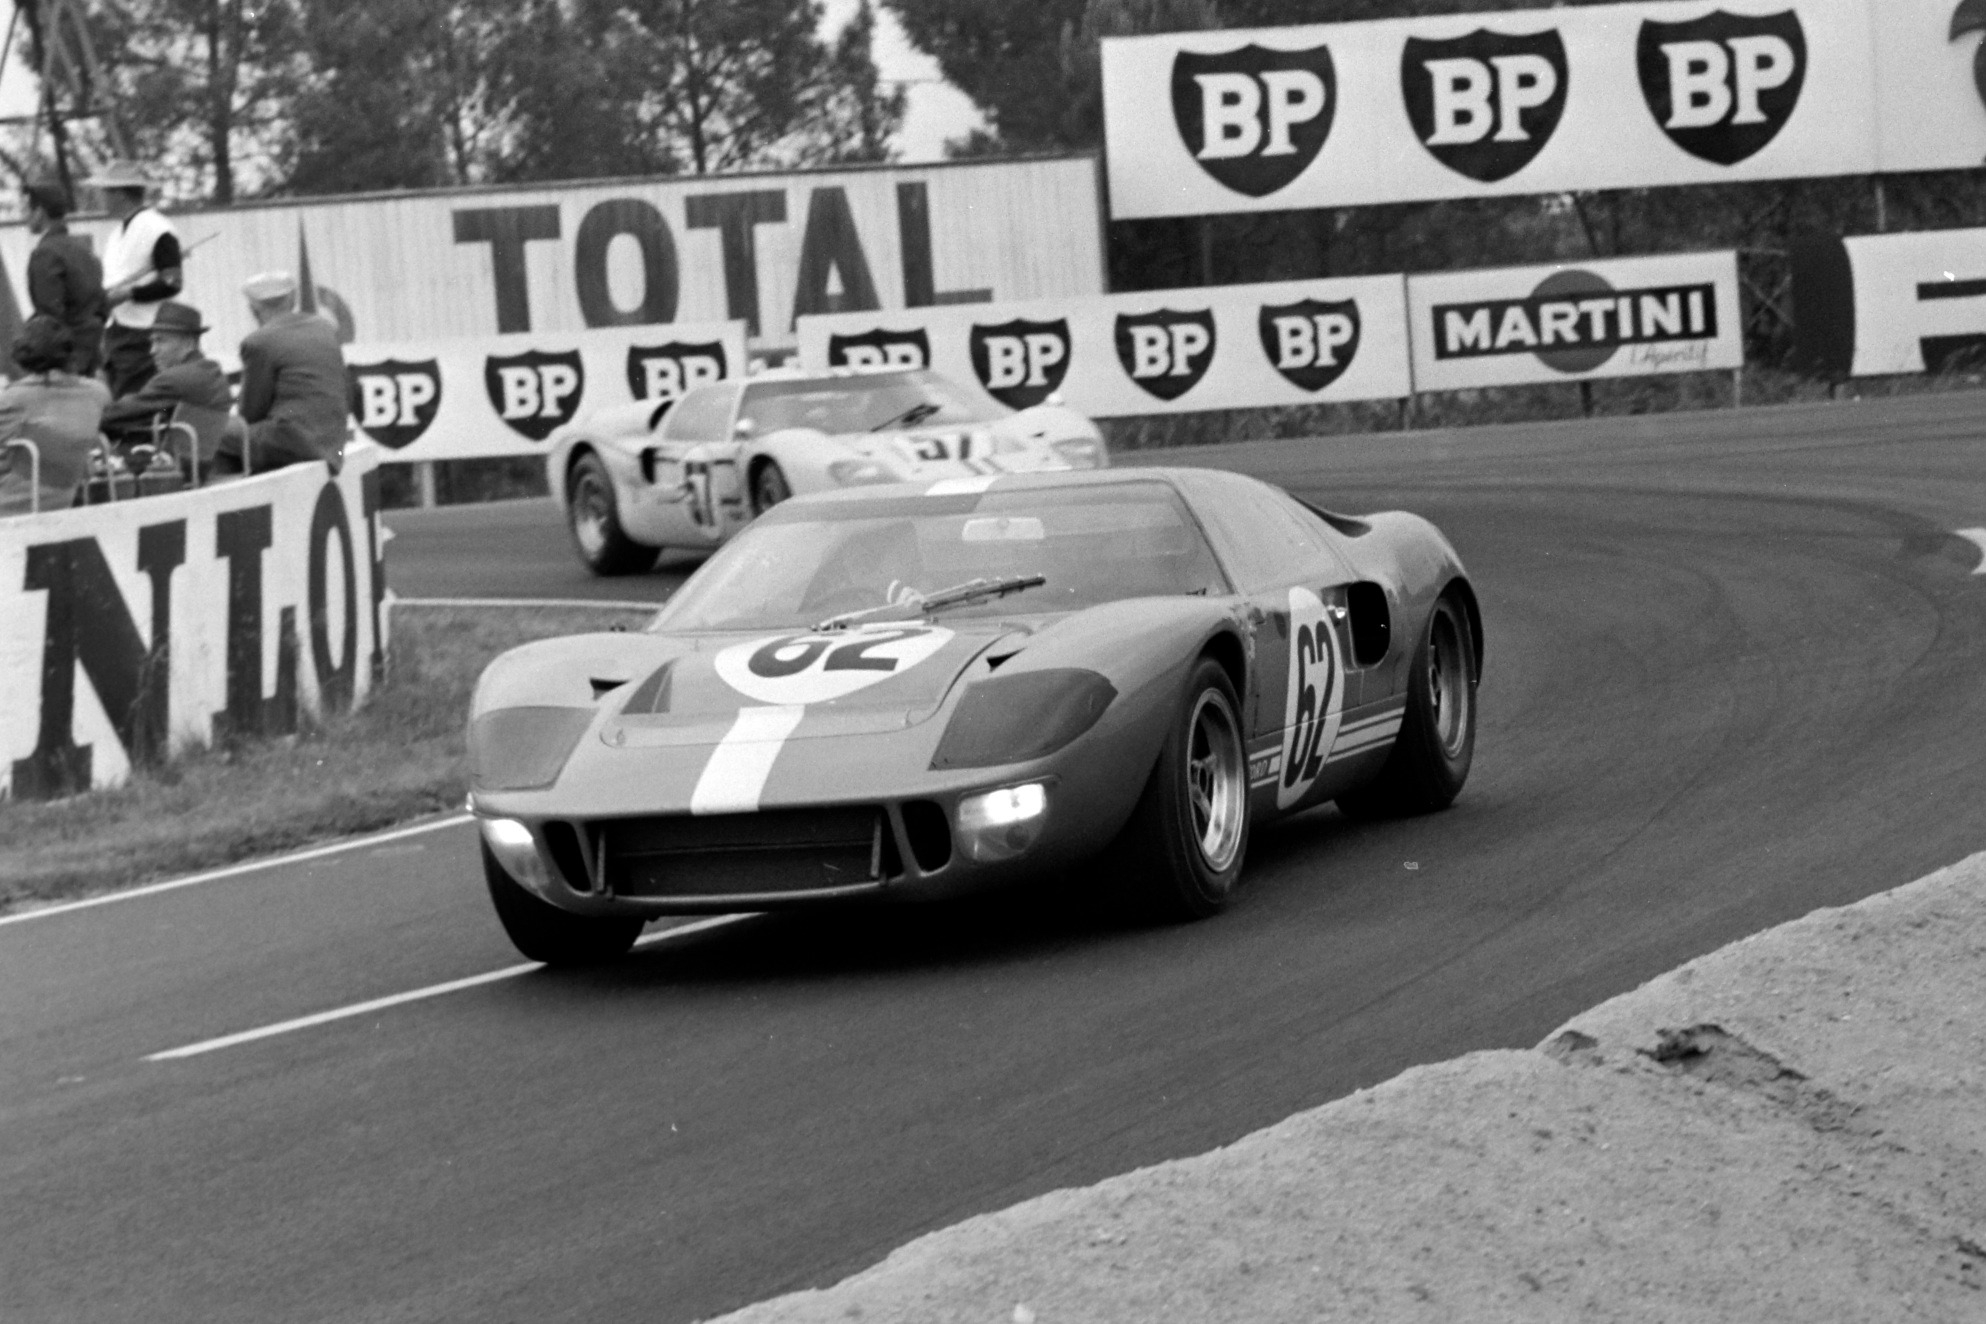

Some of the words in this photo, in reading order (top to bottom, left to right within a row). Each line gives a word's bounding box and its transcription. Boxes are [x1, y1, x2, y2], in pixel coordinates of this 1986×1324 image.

[1193, 69, 1326, 160] BP
[1423, 53, 1557, 147] BP
[1659, 35, 1795, 129] BP
[452, 181, 994, 339] TOTAL
[984, 333, 1065, 389] BP
[1128, 322, 1209, 378] BP
[1272, 312, 1354, 369] BP
[1445, 291, 1705, 352] MARTINI
[358, 372, 436, 428] BP
[498, 363, 578, 420] BP
[748, 628, 933, 679] 62
[1284, 620, 1336, 789] 62
